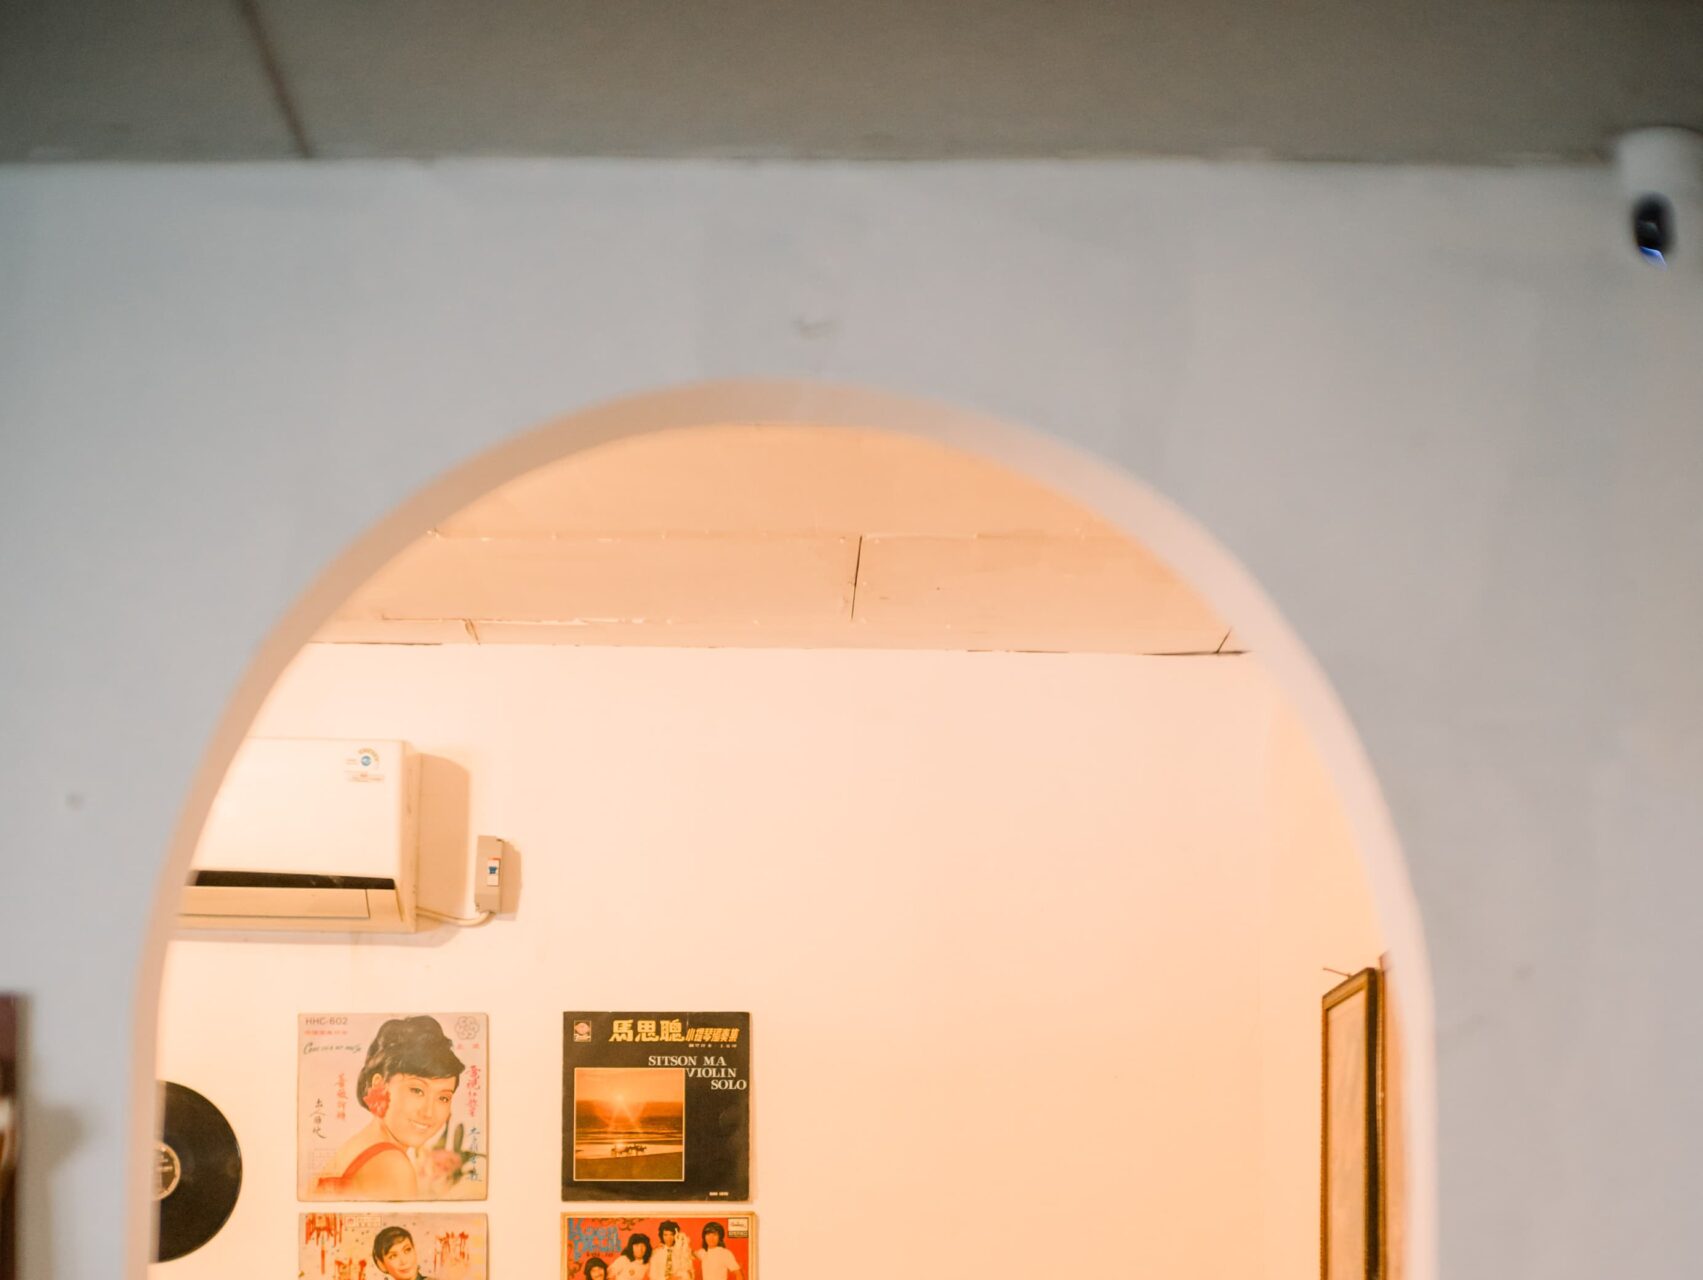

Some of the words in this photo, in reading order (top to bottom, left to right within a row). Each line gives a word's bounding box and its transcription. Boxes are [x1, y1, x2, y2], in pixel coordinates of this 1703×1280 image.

[609, 1019, 685, 1042] 馬思聰
[648, 1055, 697, 1066] SITSON
[703, 1056, 727, 1066] MA
[687, 1067, 737, 1077] VIOLIN
[710, 1080, 747, 1090] SOLO
